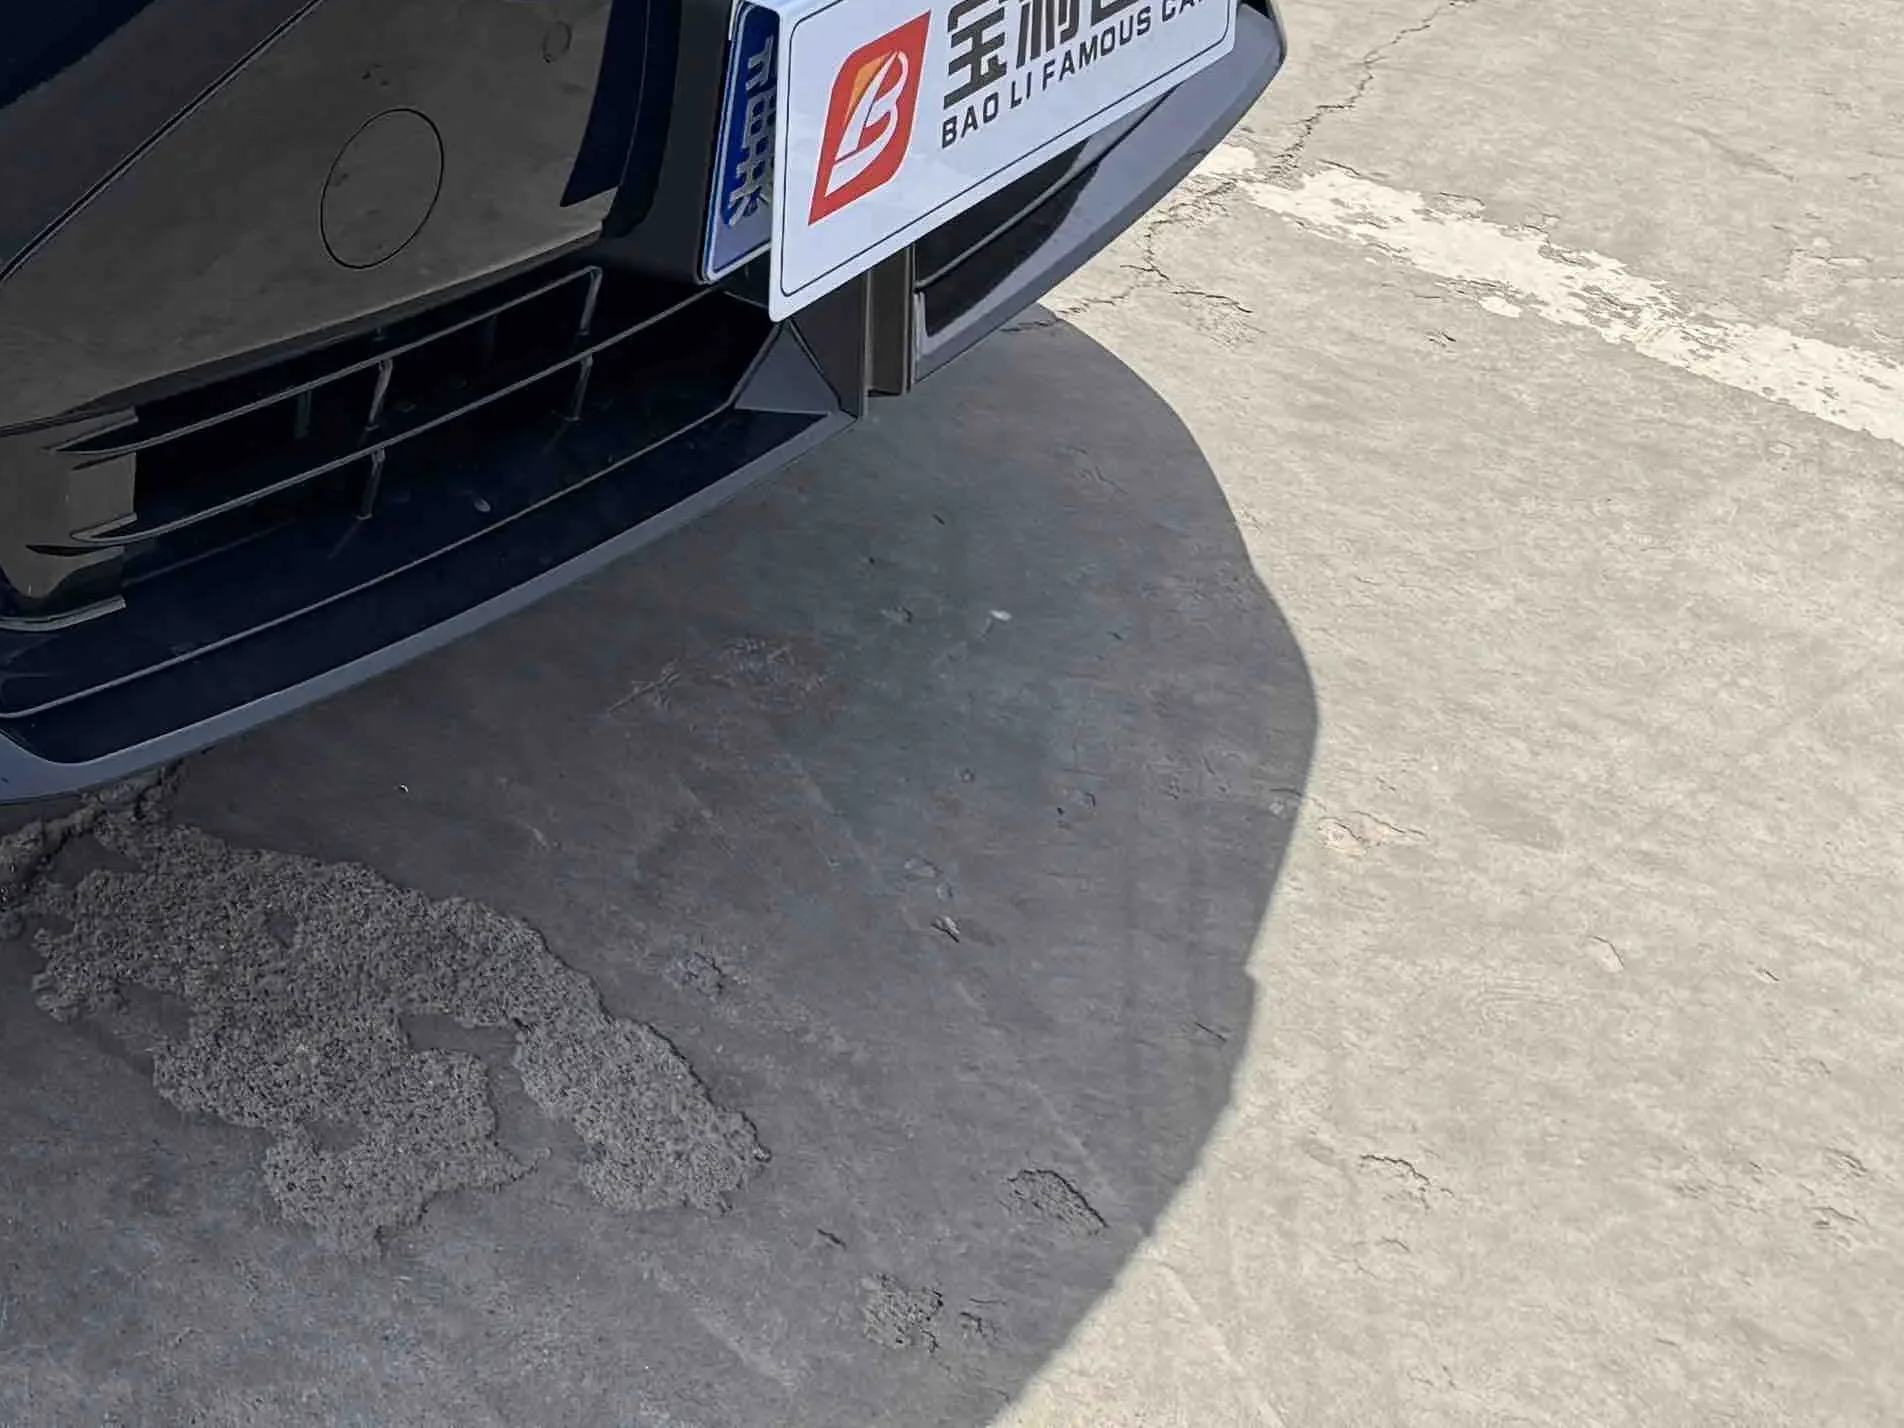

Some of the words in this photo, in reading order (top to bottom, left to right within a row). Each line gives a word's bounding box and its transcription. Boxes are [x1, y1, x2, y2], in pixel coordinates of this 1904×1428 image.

[942, 92, 999, 149] BAO
[1010, 71, 1033, 110] LI
[1042, 6, 1152, 91] FAMOUS
